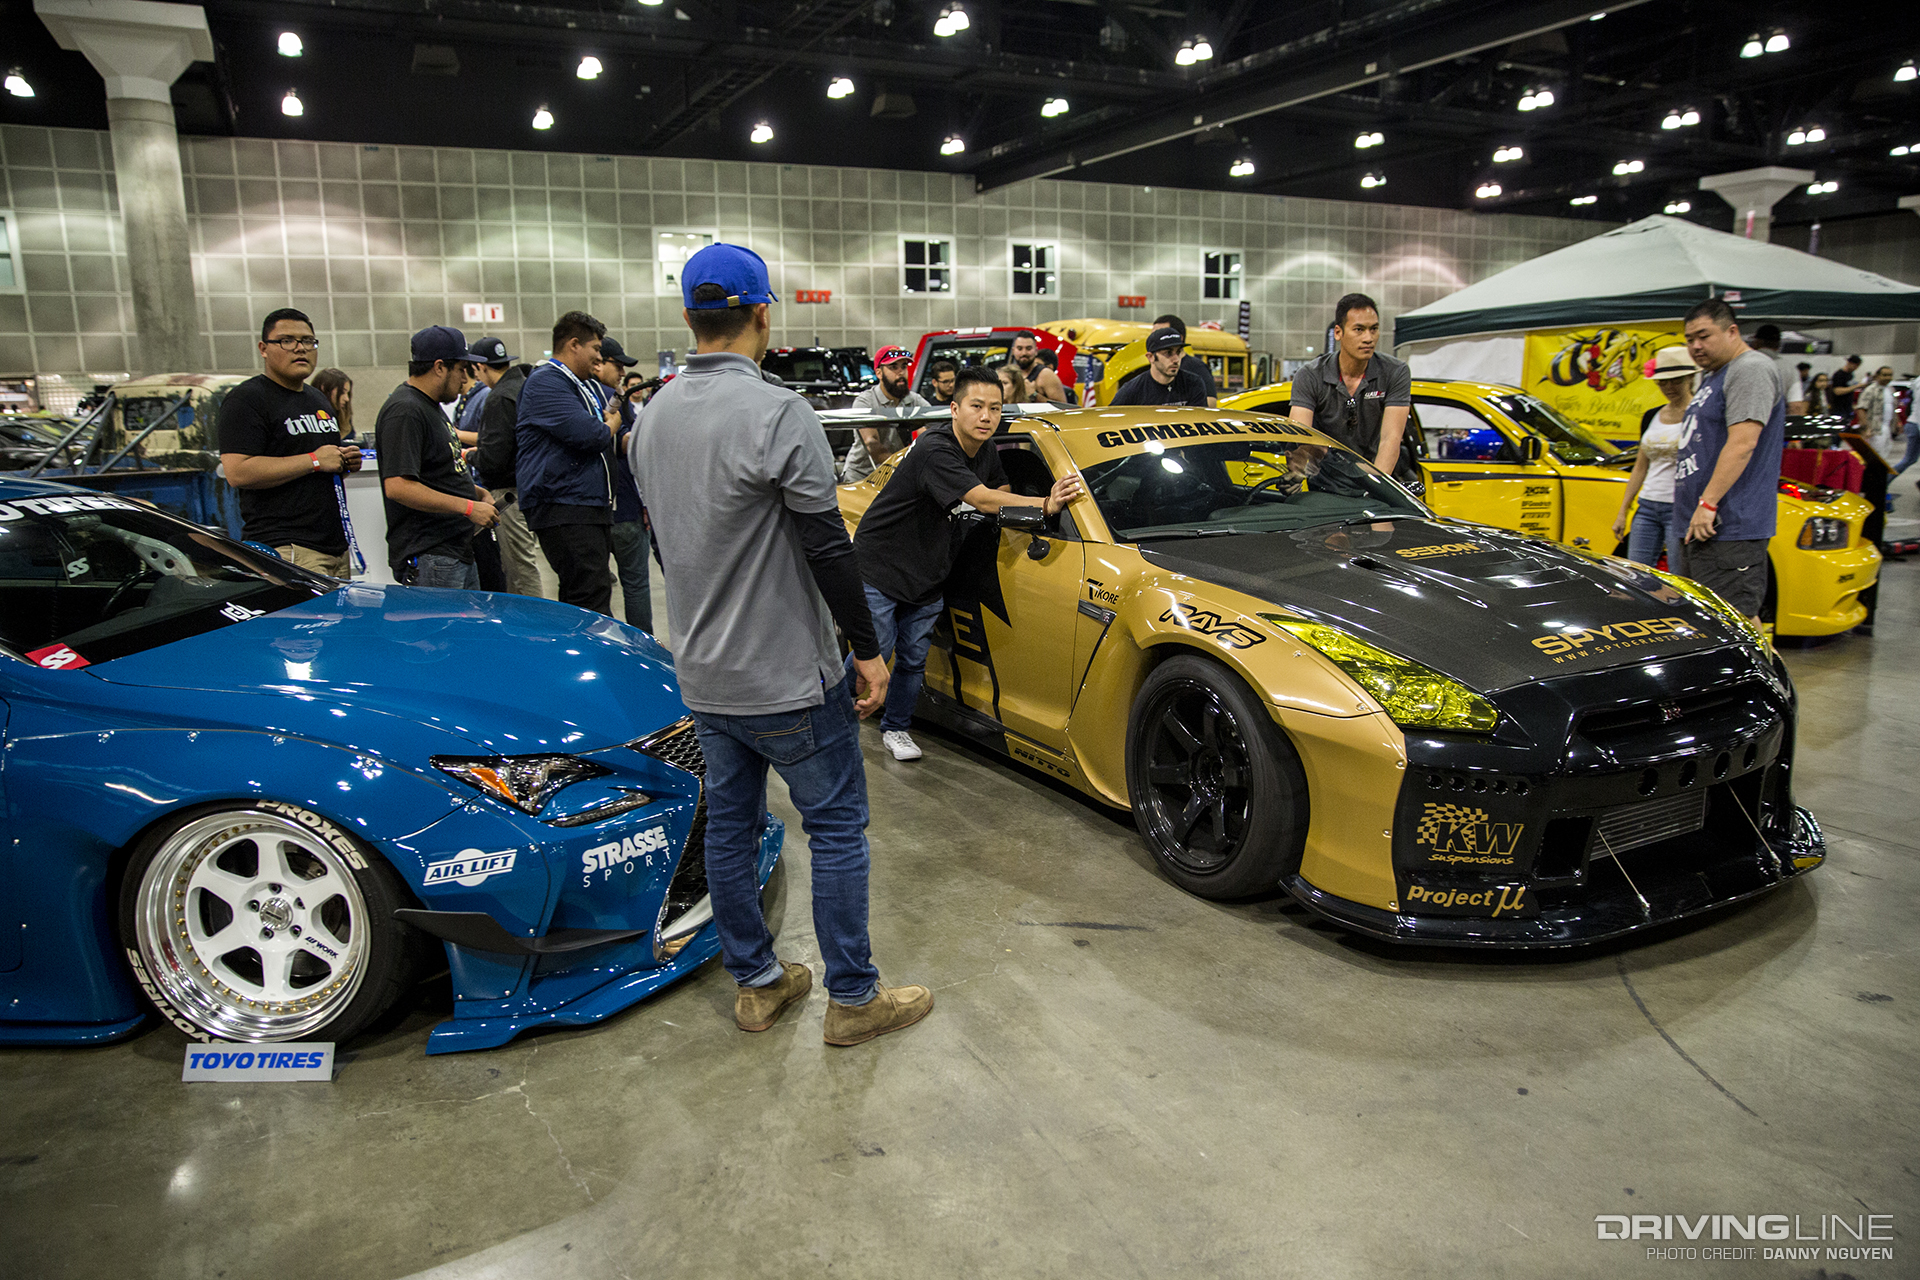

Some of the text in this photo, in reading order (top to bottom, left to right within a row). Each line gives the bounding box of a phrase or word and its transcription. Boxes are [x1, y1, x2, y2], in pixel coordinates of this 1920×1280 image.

[796, 290, 832, 303] EXIT
[1096, 420, 1313, 448] GUMBALL 3000
[1395, 542, 1480, 558] SEBON
[1158, 602, 1267, 649] RAYS
[1531, 617, 1699, 655] SPYDER
[256, 799, 369, 871] PROXES
[582, 825, 669, 874] STRASSE
[1432, 820, 1525, 855] KW
[429, 855, 512, 880] AIR LIFT
[583, 846, 671, 888] SPORT
[1428, 854, 1515, 866] suspensions
[190, 1051, 325, 1070] TOYO TIRES
